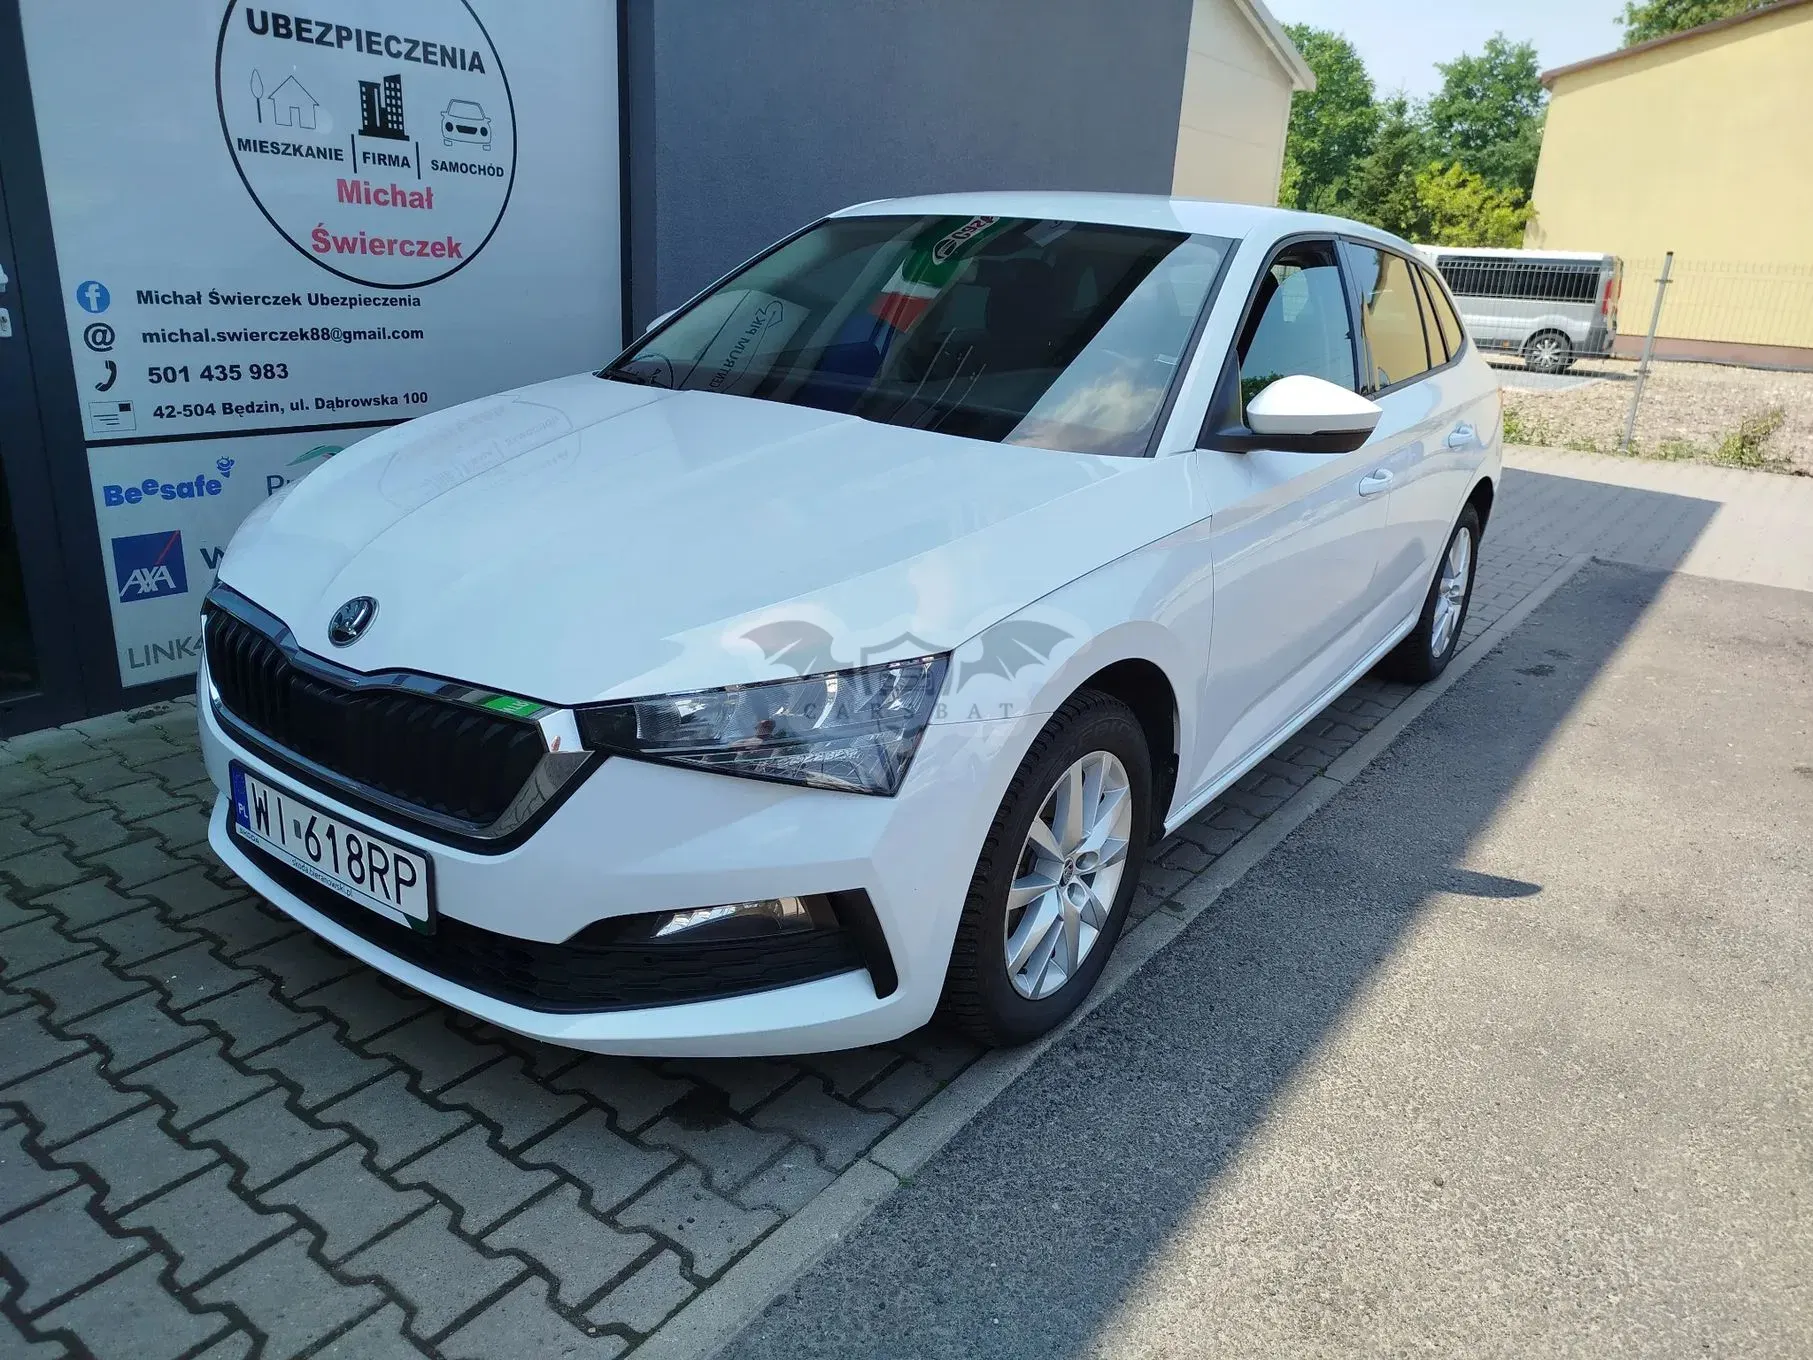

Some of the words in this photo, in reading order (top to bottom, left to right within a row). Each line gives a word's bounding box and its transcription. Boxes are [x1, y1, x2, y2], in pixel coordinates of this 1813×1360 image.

[245, 7, 486, 75] UBEZPIECZENIA
[236, 137, 344, 163] MIESZKANIE
[362, 151, 411, 170] FIRMA
[430, 159, 505, 178] SAMOCHÓD
[336, 178, 434, 210] Michał
[310, 222, 463, 259] Świerczek
[136, 289, 202, 306] Michał
[208, 287, 302, 307] Świerczek
[307, 292, 421, 310] Ubezpieczenia
[141, 326, 424, 344] michal.swierczek88@gmail.com
[148, 365, 190, 384] 501
[199, 364, 242, 382] 435
[249, 362, 289, 380] 983
[152, 402, 217, 419] 42-504
[222, 400, 285, 418] Będzin,
[289, 397, 310, 413] ul.
[315, 393, 399, 412] Dąbrowska
[403, 391, 428, 405] 100
[103, 474, 222, 507] Beesafe
[119, 565, 177, 598] AXA
[238, 802, 249, 819] PL
[251, 782, 286, 846] WI
[304, 814, 418, 906] 618RP
